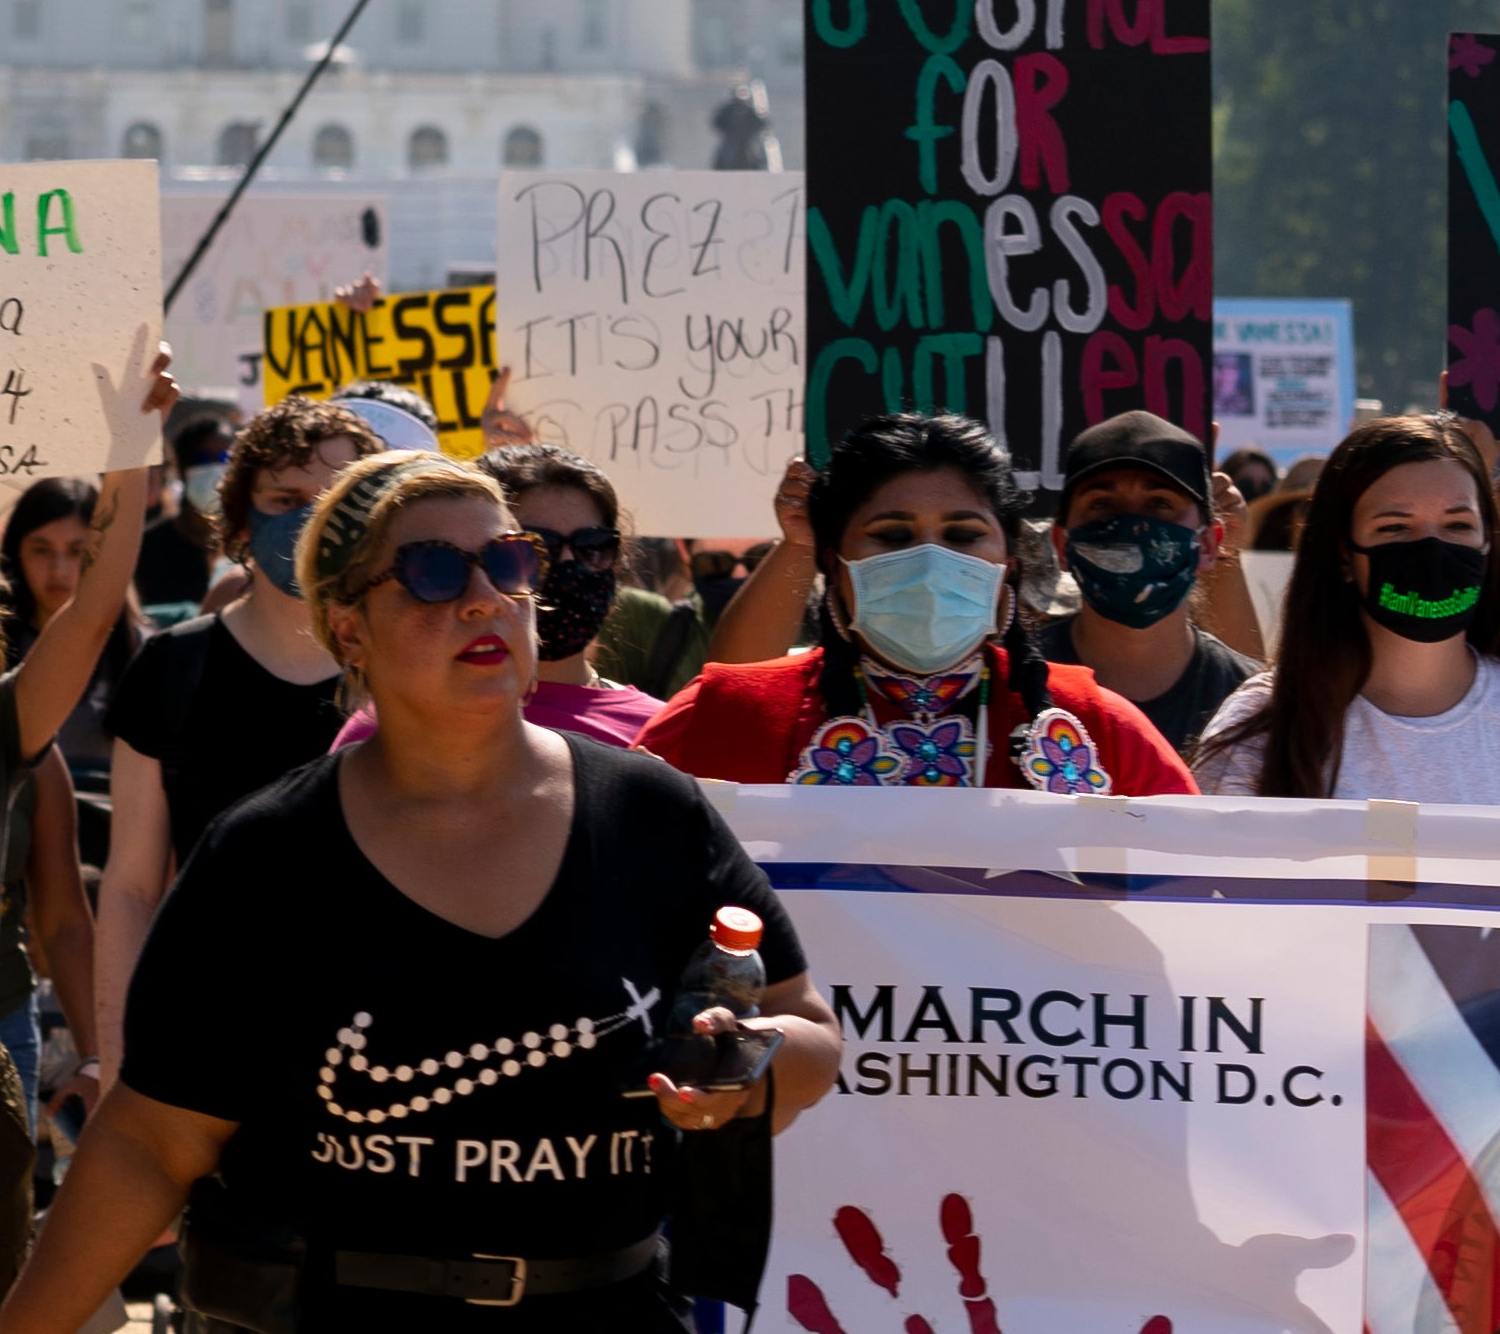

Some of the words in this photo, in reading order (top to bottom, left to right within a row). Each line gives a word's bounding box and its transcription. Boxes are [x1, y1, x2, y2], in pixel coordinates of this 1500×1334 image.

[514, 180, 723, 305] PREZ
[516, 311, 659, 381] IT'S
[0, 369, 32, 425] 4
[600, 396, 739, 460] PASS
[829, 984, 1146, 1051] MARCH
[1180, 995, 1267, 1056] IN
[1215, 1063, 1345, 1109] D.C.
[311, 1131, 435, 1177] JUST
[455, 1133, 598, 1183] PRAY
